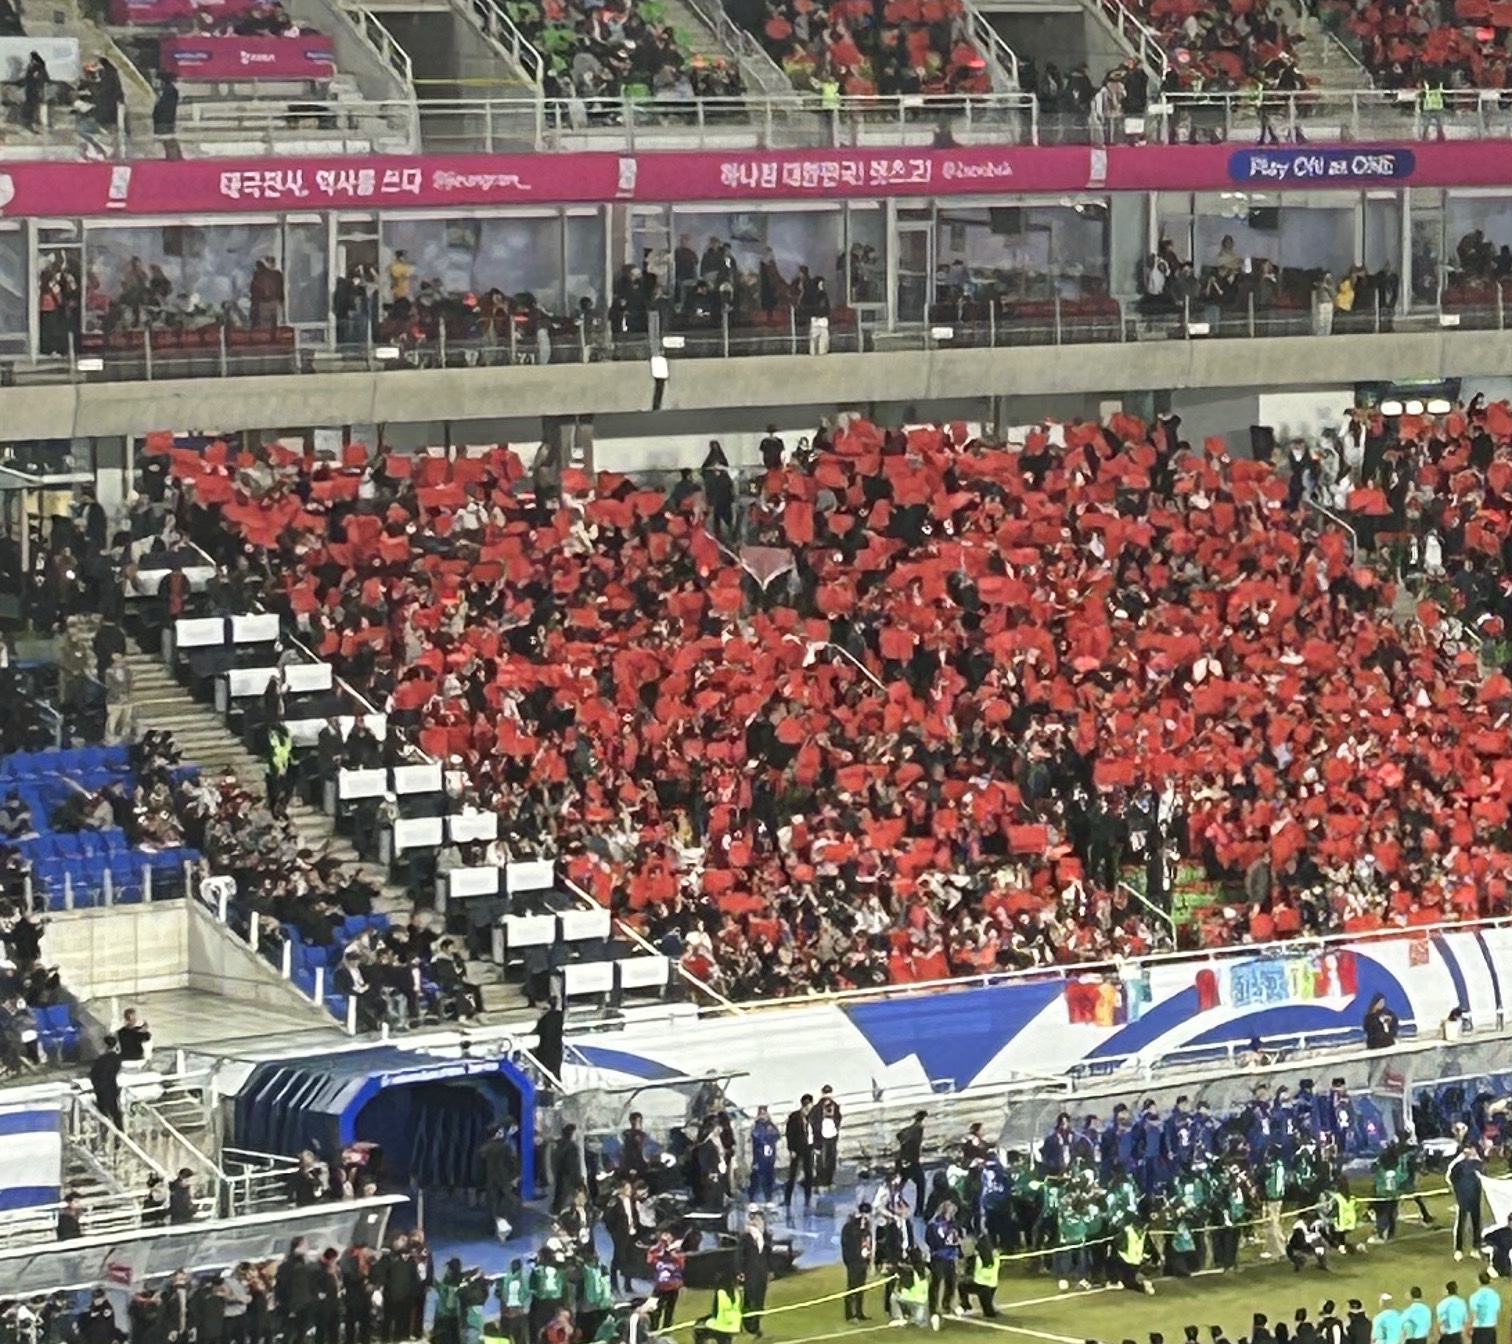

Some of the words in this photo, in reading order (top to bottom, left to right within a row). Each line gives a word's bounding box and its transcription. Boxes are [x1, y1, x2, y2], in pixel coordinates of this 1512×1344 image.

[380, 168, 423, 195] 쓰다
[782, 160, 864, 188] 대한민국
[1249, 156, 1289, 180] Play
